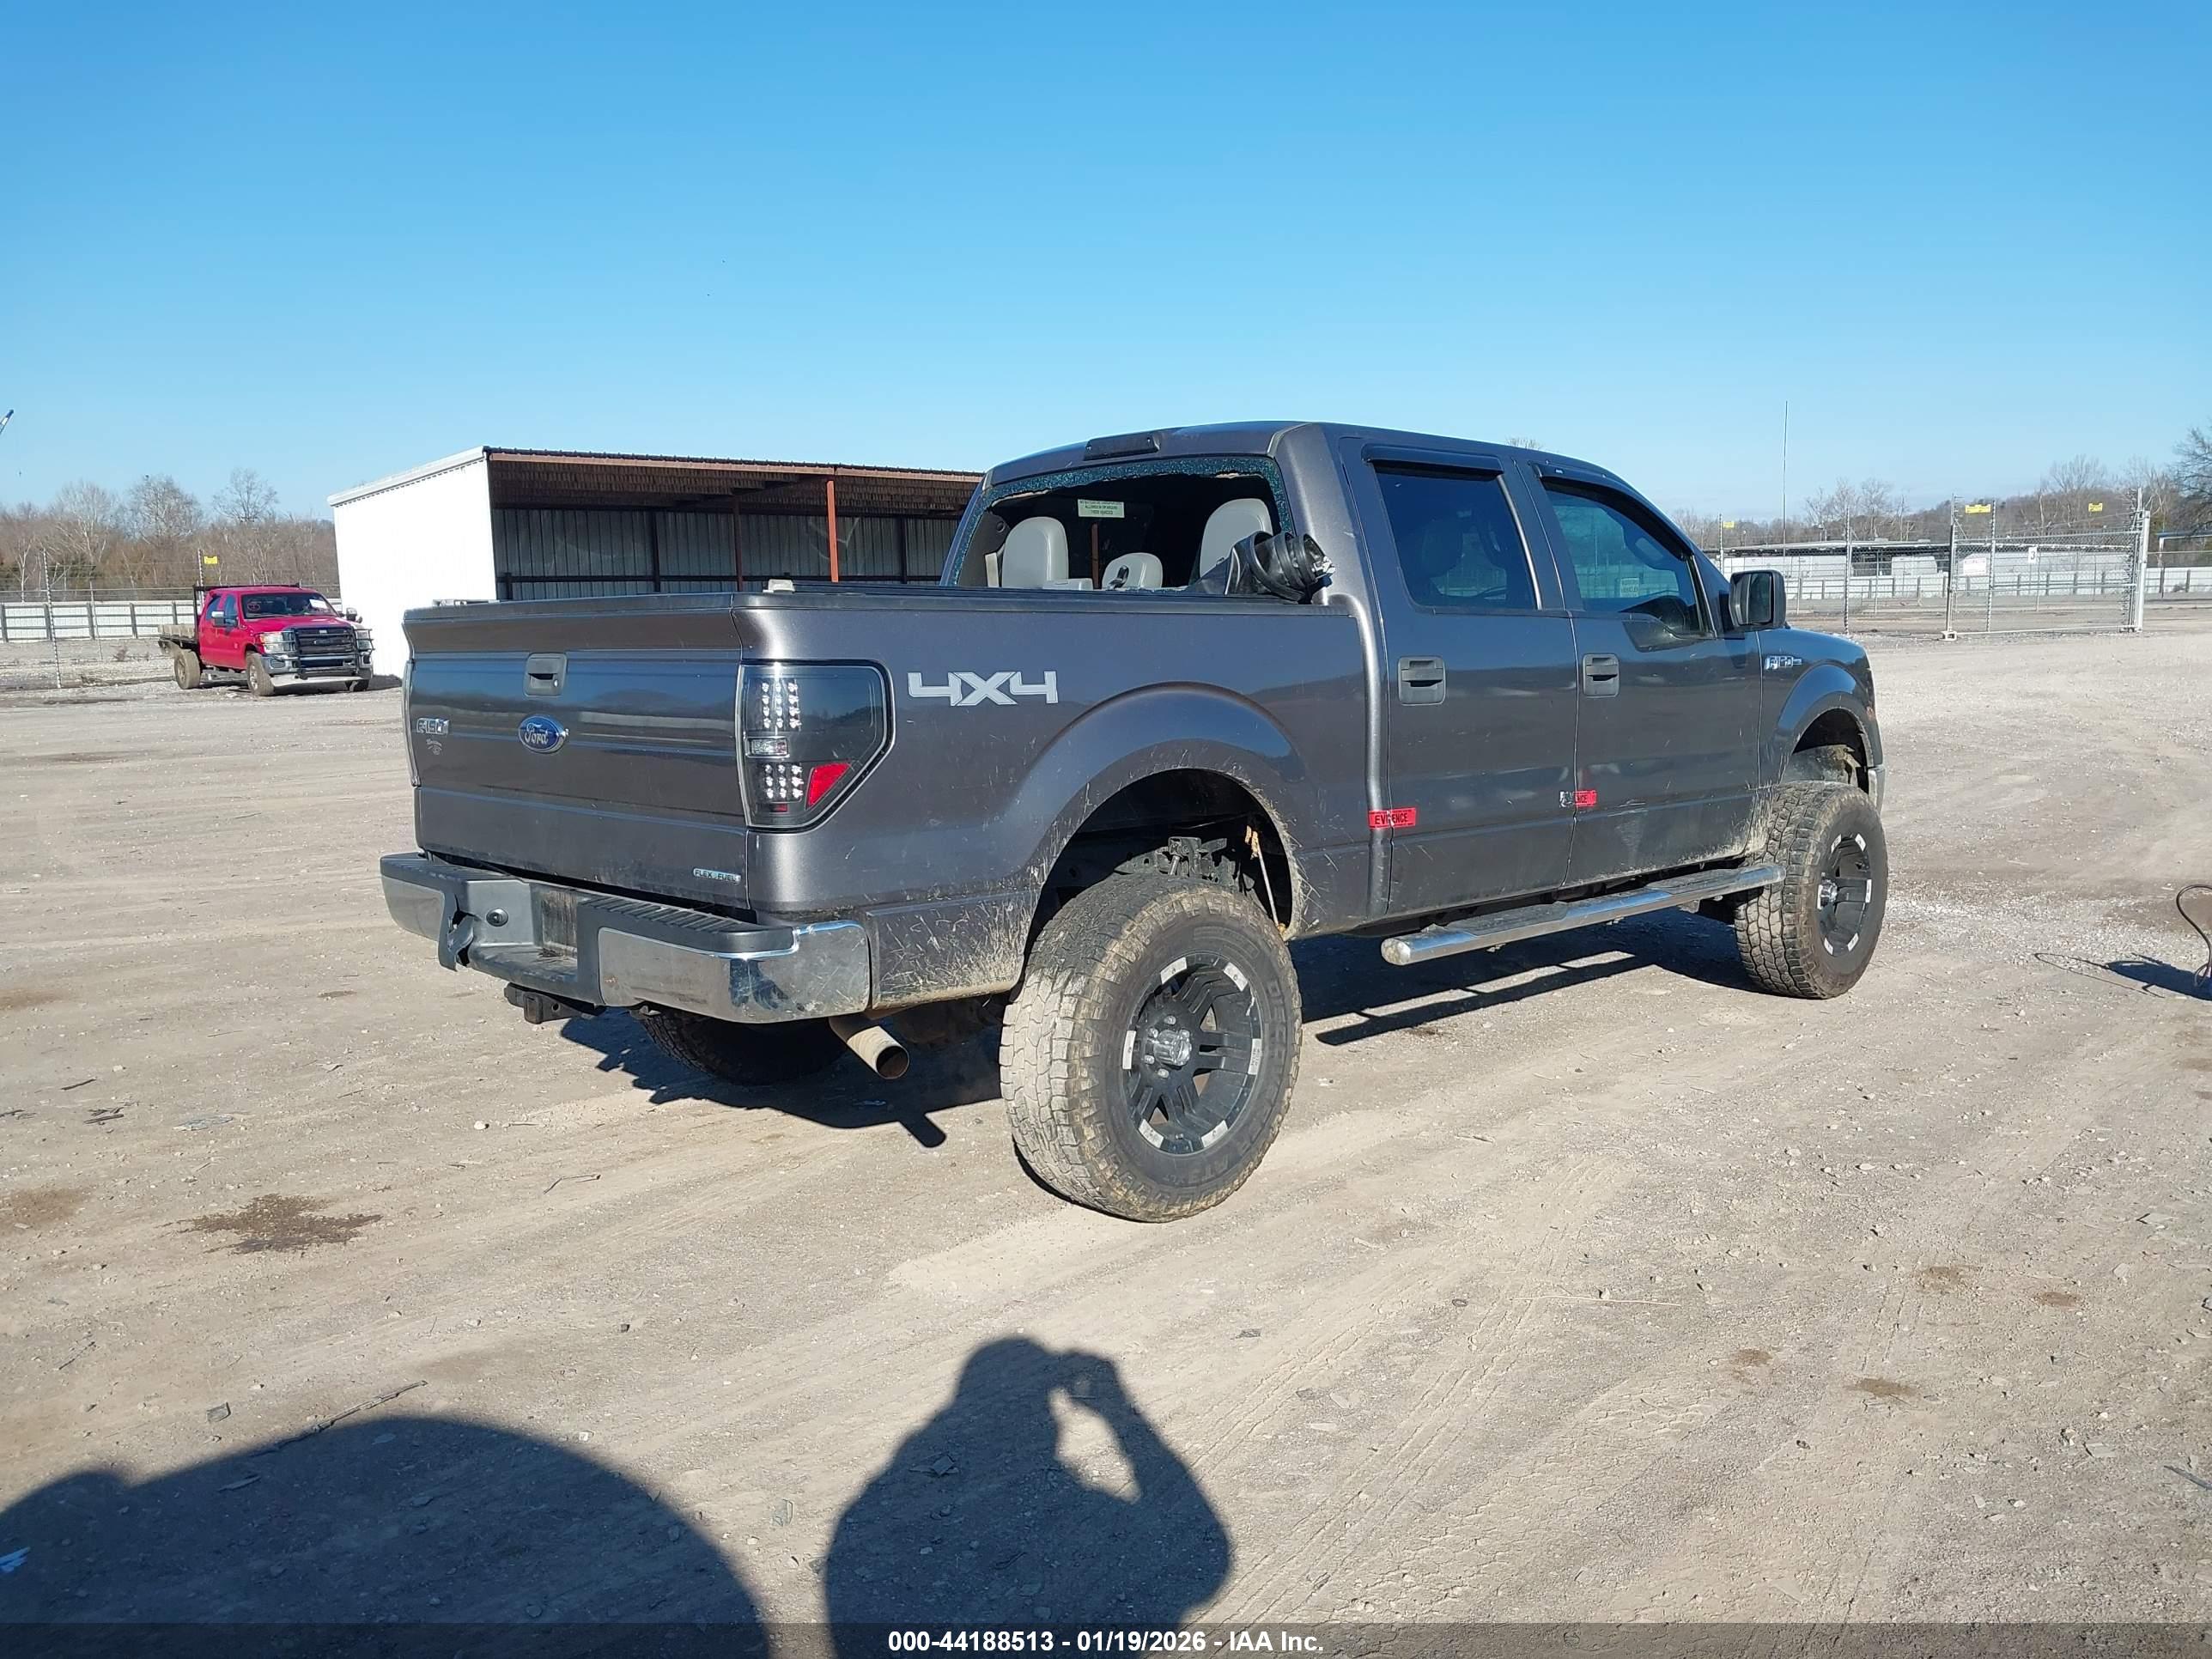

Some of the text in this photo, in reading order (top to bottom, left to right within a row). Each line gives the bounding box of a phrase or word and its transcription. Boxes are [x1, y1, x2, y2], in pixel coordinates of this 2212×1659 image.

[907, 671, 1059, 707] 4X4
[1374, 812, 1408, 825] EVIENCE
[695, 869, 736, 882] FLEX FUEL
